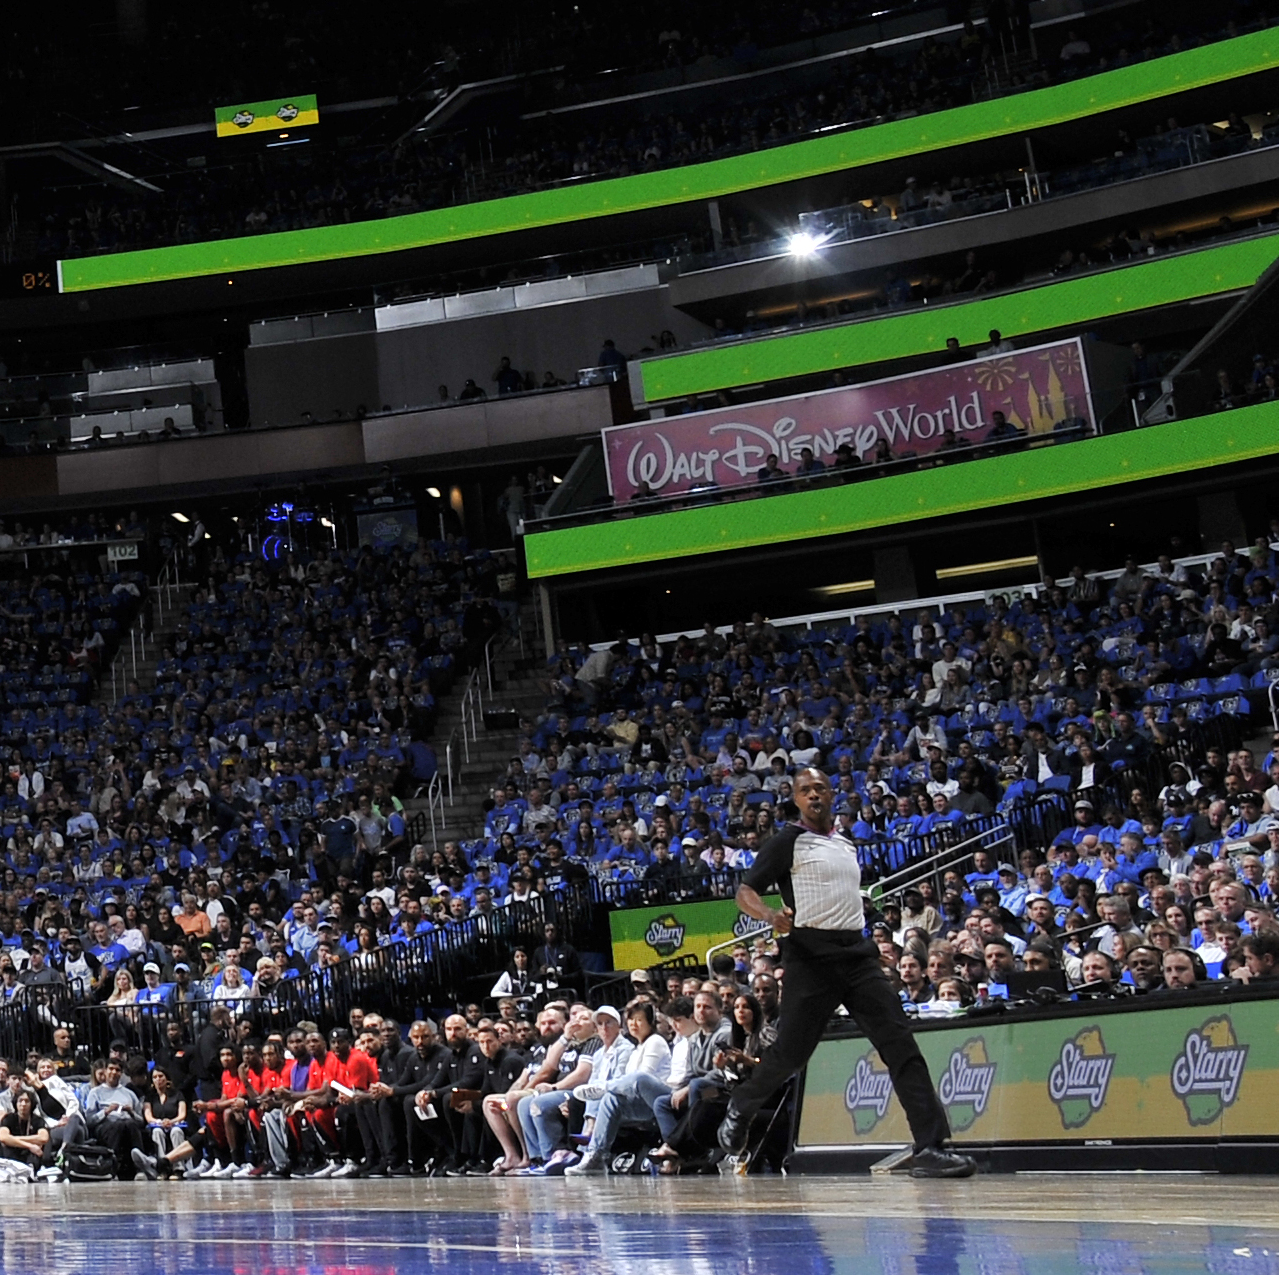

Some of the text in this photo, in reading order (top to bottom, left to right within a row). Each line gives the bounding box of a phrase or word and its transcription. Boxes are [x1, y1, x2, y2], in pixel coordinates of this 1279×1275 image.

[22, 271, 51, 290] 0%
[874, 390, 986, 444] World
[111, 545, 138, 559] 102
[645, 922, 684, 947] Starry
[941, 1051, 995, 1114] Starry
[1049, 1043, 1114, 1108] Starry
[1173, 1033, 1246, 1105] Starry
